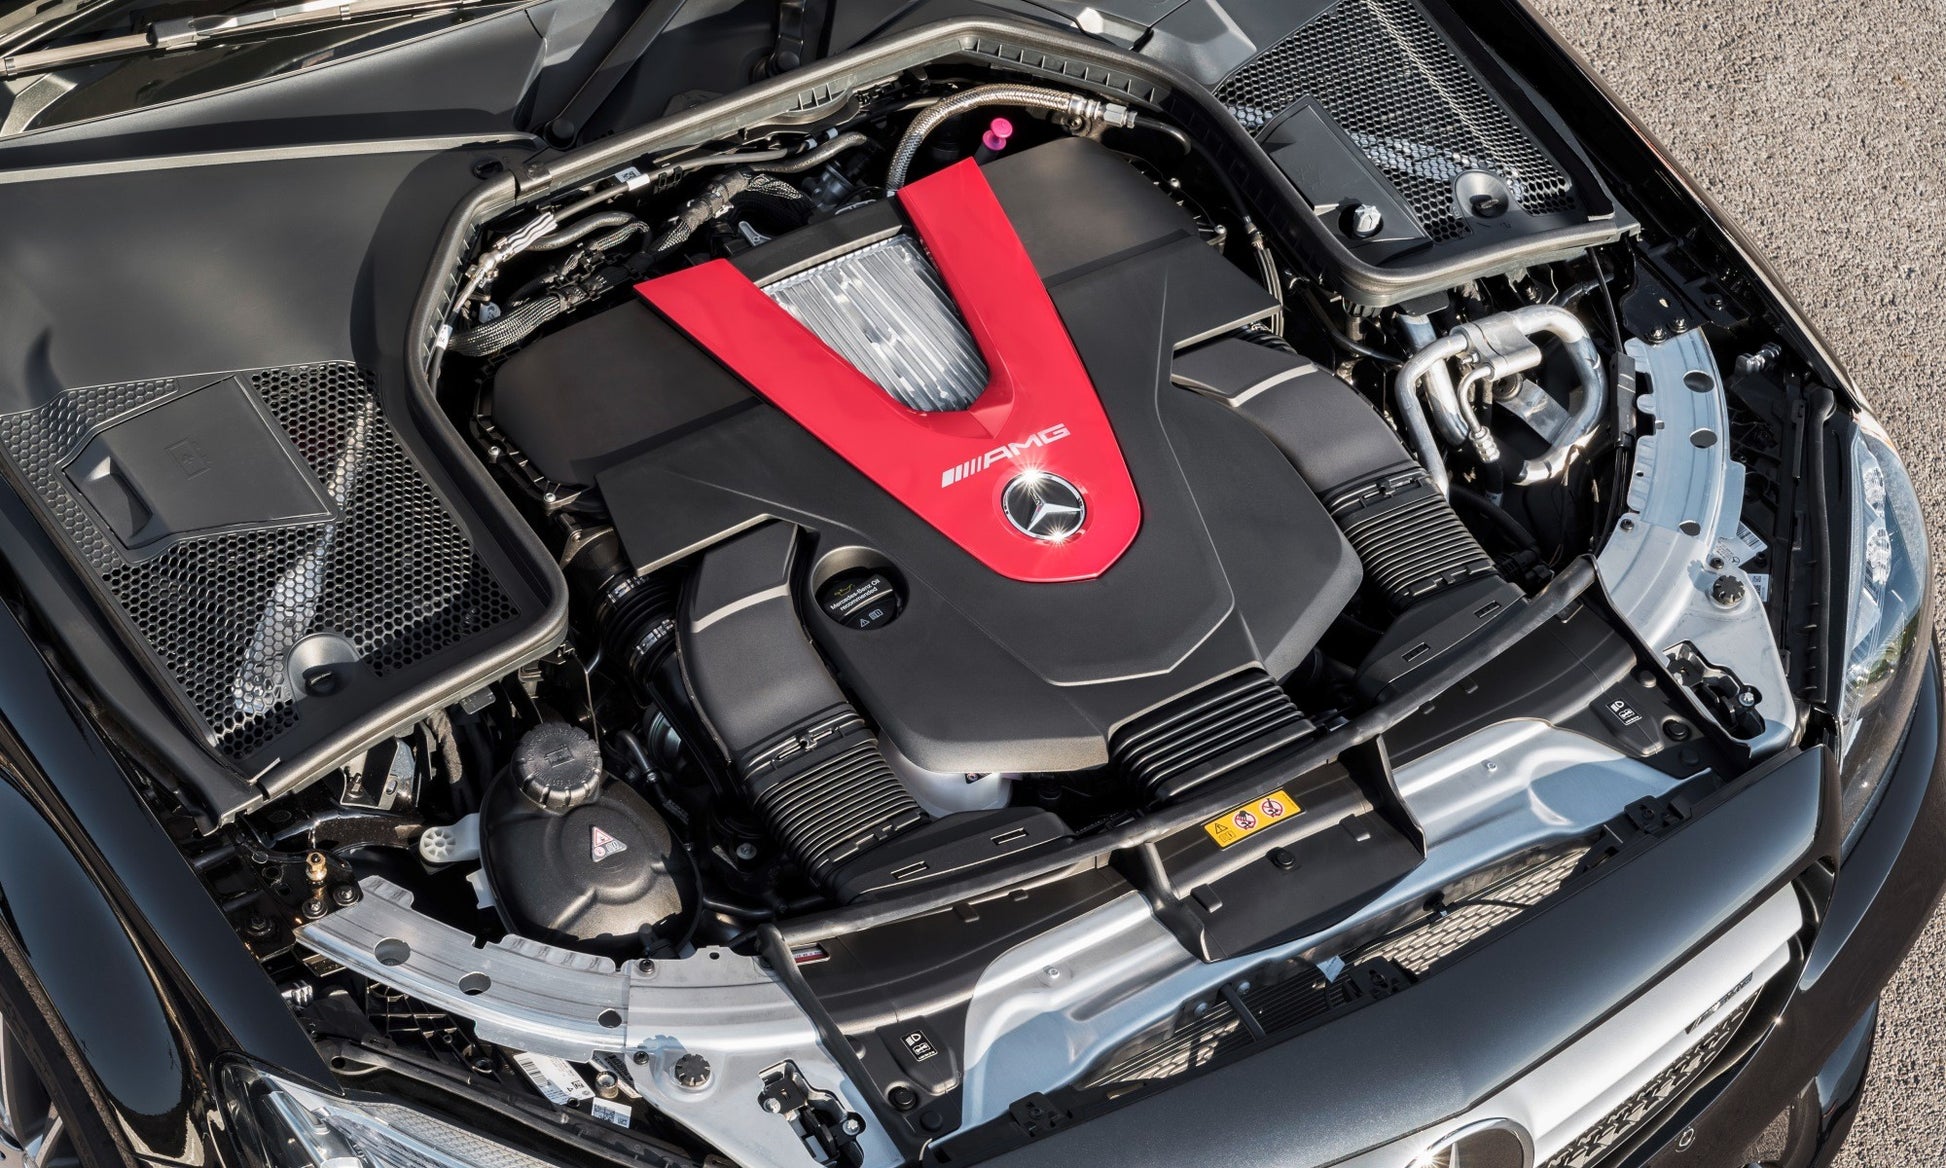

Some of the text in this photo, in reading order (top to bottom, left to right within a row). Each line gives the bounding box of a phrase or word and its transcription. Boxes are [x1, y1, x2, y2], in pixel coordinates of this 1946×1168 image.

[983, 423, 1071, 469] AMG
[830, 584, 872, 610] Mercedes-Benz
[840, 586, 878, 611] recommended
